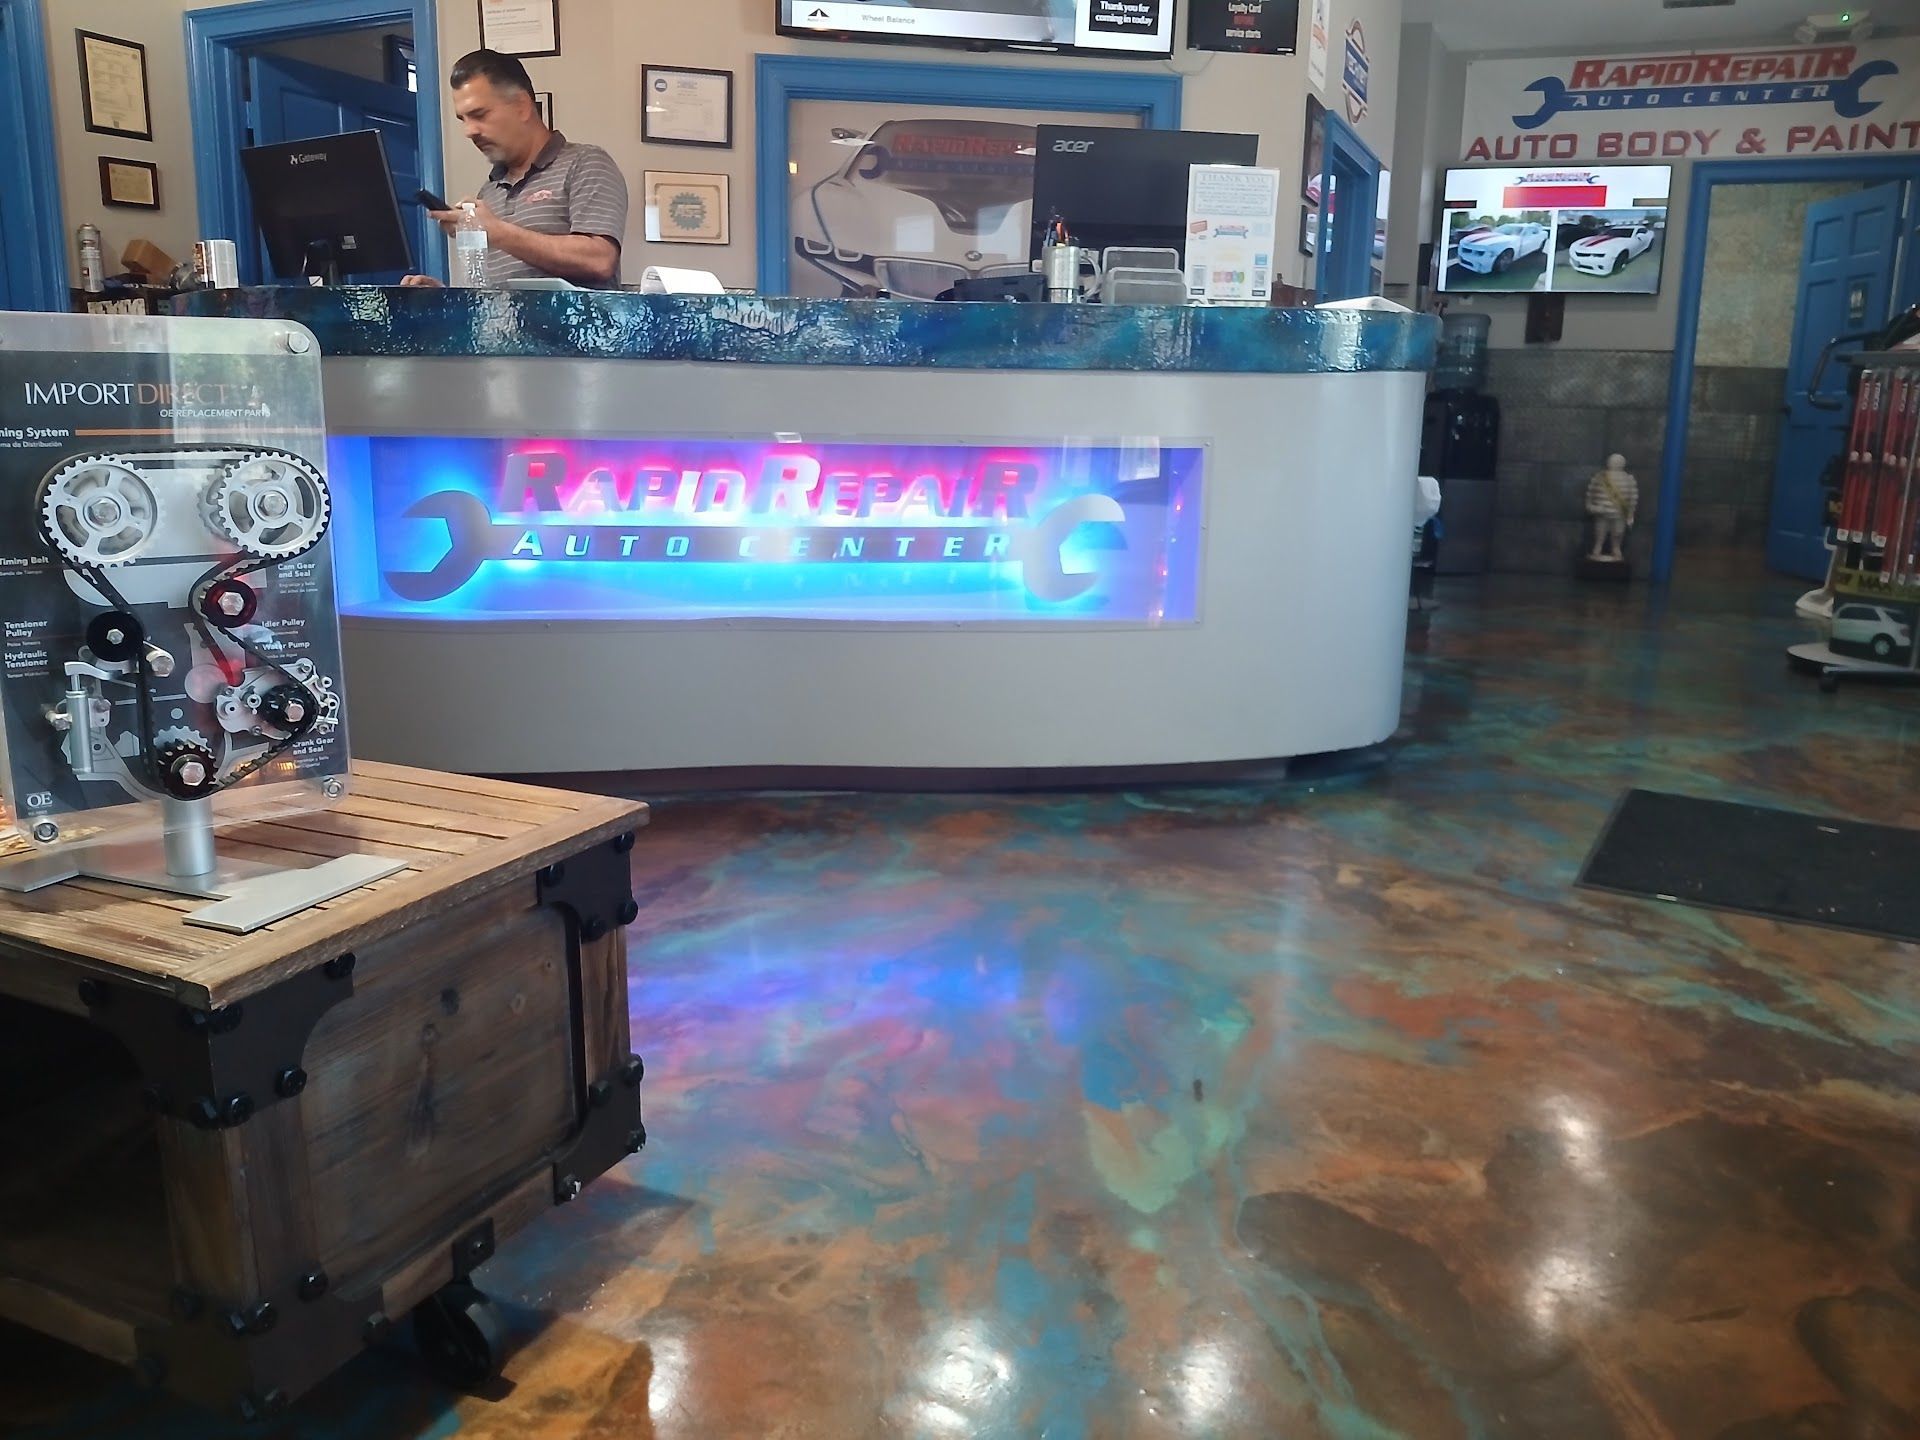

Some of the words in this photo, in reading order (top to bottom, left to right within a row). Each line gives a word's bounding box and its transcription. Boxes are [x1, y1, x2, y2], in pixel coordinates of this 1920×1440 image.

[1123, 4, 1138, 13] you
[1138, 3, 1150, 12] for
[861, 14, 884, 23] Wheel
[886, 15, 916, 24] Balance
[1095, 13, 1123, 25] coming
[1132, 15, 1153, 26] today
[1572, 92, 1660, 108] AUTO
[1682, 84, 1830, 104] CENTER
[1052, 139, 1094, 153] acer
[1464, 133, 1579, 162] AUTO
[1596, 128, 1721, 159] BODY
[1735, 127, 1767, 154] &
[1786, 120, 1920, 153] PAINT
[299, 152, 327, 163] Gateway
[159, 408, 174, 418] OE
[176, 408, 243, 418] REPLACEMENT
[26, 426, 70, 440] System
[511, 528, 690, 558] AUTO
[737, 532, 1012, 558] CENTER
[0, 557, 28, 566] Timing
[30, 556, 49, 564] Belt
[297, 562, 316, 570] Gear
[294, 570, 311, 578] Seal
[4, 620, 48, 630] Tensioner
[281, 619, 306, 628] Pulley
[5, 629, 33, 638] Pulley
[288, 641, 310, 650] Pump
[4, 650, 48, 661] Hydraulic
[4, 659, 49, 669] Tensioner
[316, 737, 334, 745] Gear
[292, 747, 307, 756] and
[308, 745, 324, 753] Seal
[26, 791, 53, 808] OE
